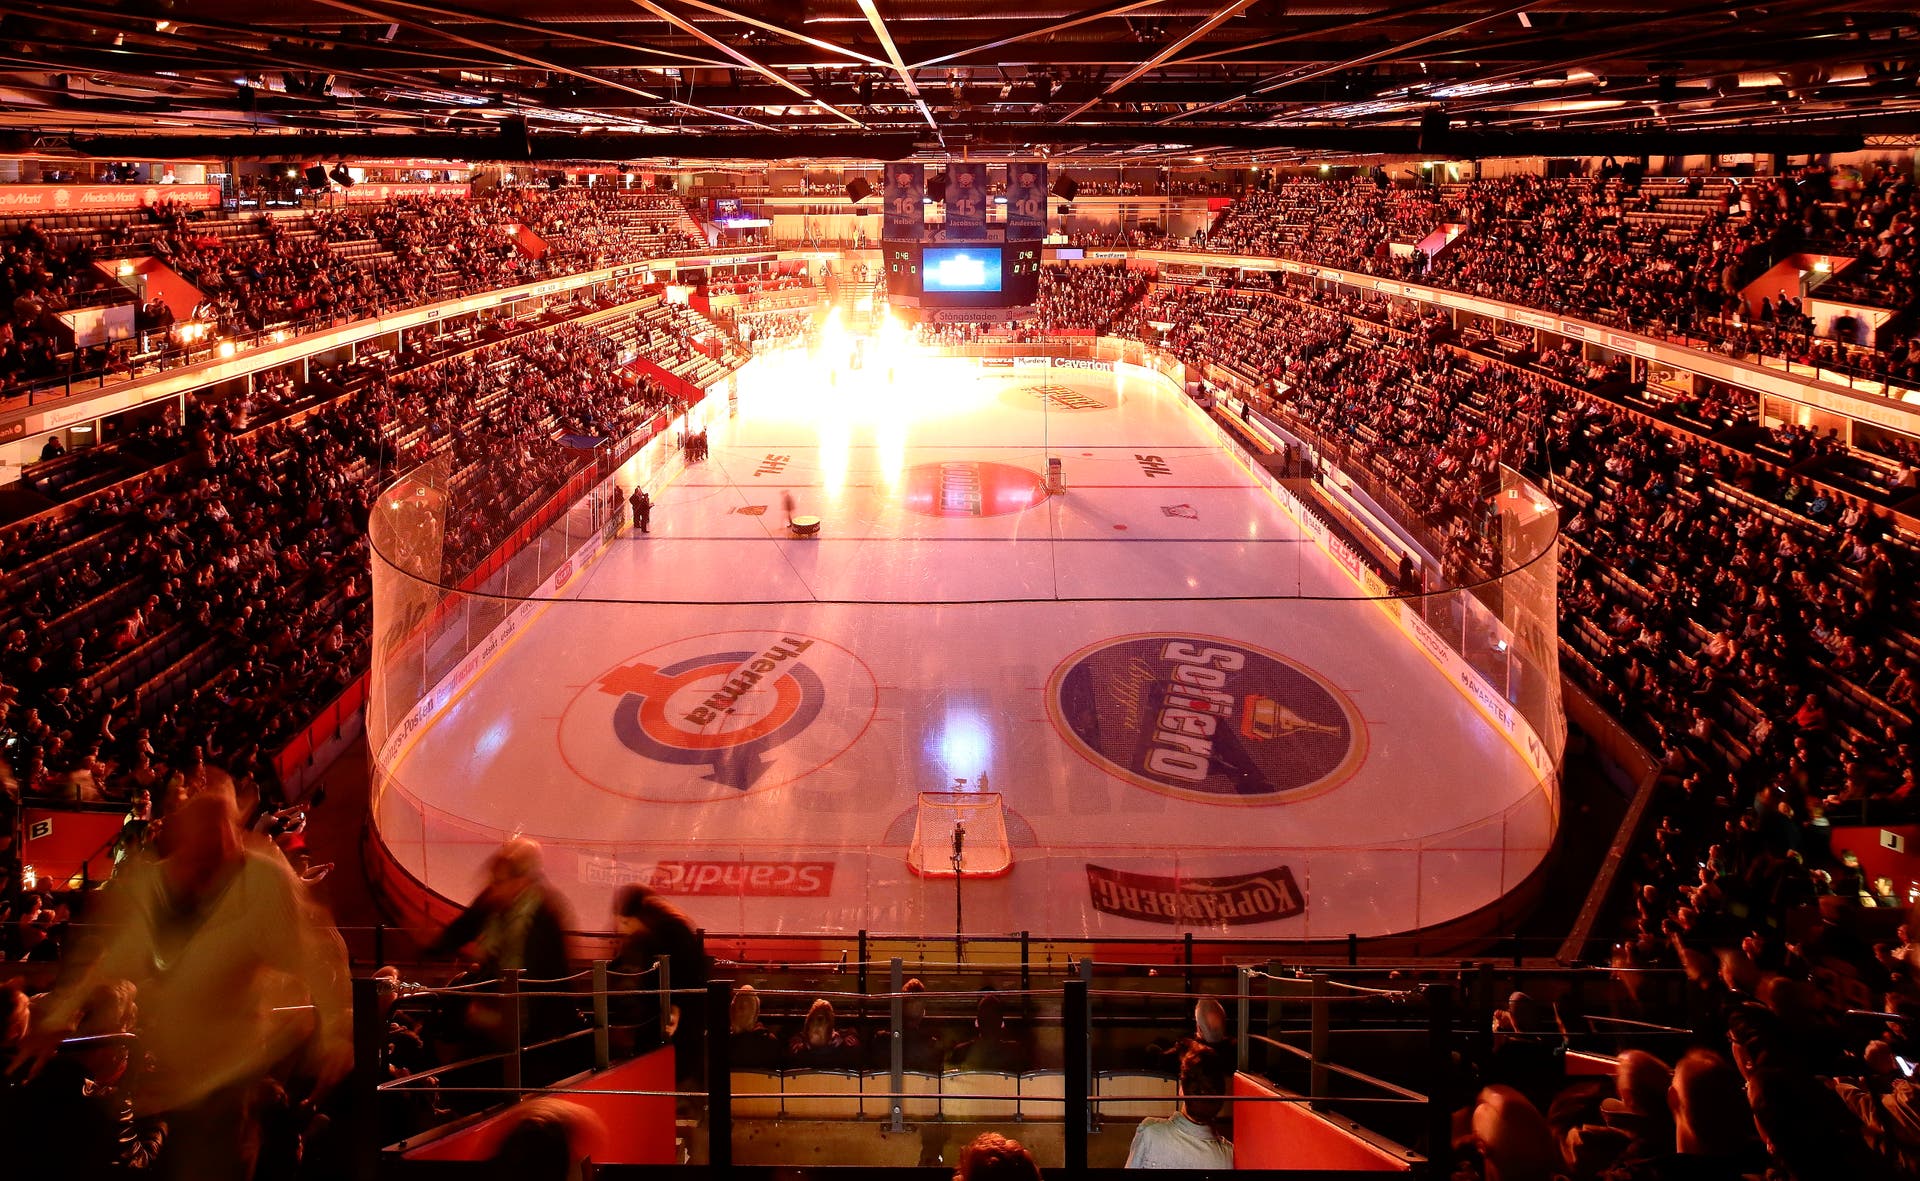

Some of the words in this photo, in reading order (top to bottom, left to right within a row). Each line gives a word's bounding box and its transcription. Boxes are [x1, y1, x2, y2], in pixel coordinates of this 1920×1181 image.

[893, 197, 915, 214] 16
[956, 199, 976, 215] 15
[1015, 199, 1039, 216] 10
[1054, 358, 1111, 372] Caverion
[684, 636, 814, 726] Thermia
[32, 822, 48, 838] B
[662, 864, 824, 893] Scandic
[1101, 878, 1297, 919] KOPPARBERG
